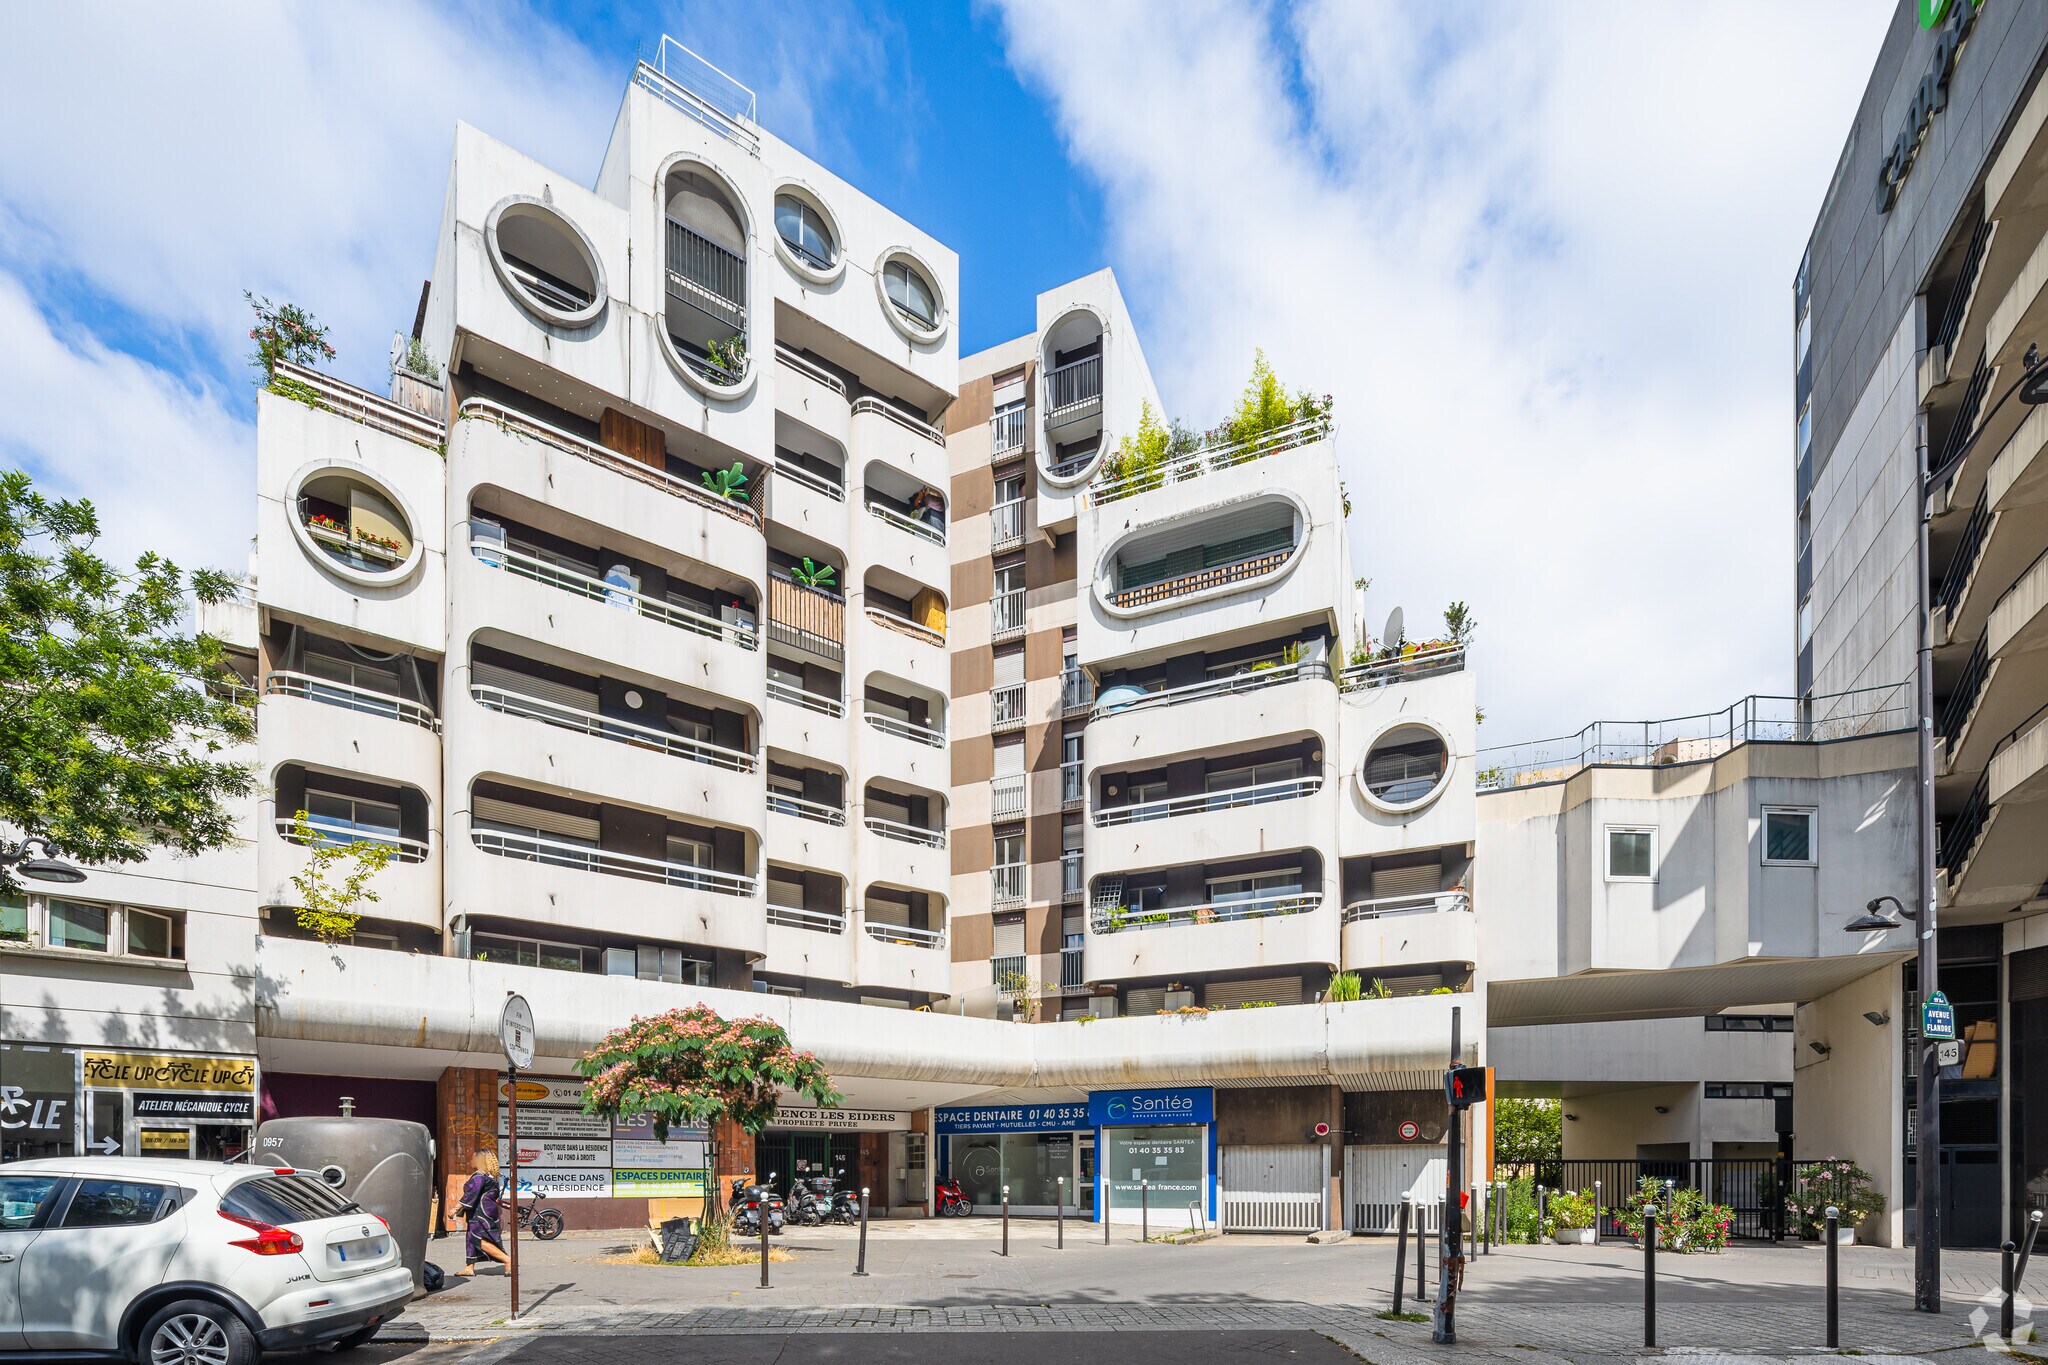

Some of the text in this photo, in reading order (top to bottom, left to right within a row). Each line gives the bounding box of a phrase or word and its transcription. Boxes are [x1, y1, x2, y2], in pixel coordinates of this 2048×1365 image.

[1928, 1010, 1950, 1019] AVENUE
[1927, 1024, 1952, 1033] FLANDRE
[1940, 1048, 1957, 1058] 145
[85, 1064, 130, 1080] YCLE
[138, 1099, 249, 1113] ATELIER MÉCANIQUE CYCLE
[1132, 1095, 1193, 1110] Santéa
[820, 1111, 845, 1120] LES
[848, 1112, 896, 1122] EIDERS
[973, 1110, 1023, 1122] DENTAIRE
[1029, 1109, 1040, 1120] 01
[1043, 1109, 1055, 1119] 40
[1058, 1108, 1069, 1119] 35
[1072, 1107, 1085, 1118] 35
[616, 1113, 647, 1127] LES
[777, 1119, 858, 1128] PROPRIÉTÉ PRIVÉE
[543, 1143, 566, 1151] BOUTIQUE
[1175, 1146, 1185, 1154] 83
[537, 1174, 605, 1182] AGENCE DANS
[615, 1171, 658, 1180] ESPACES
[537, 1182, 604, 1192] LA RÉSIDENCE
[286, 1274, 311, 1284] JUKE
